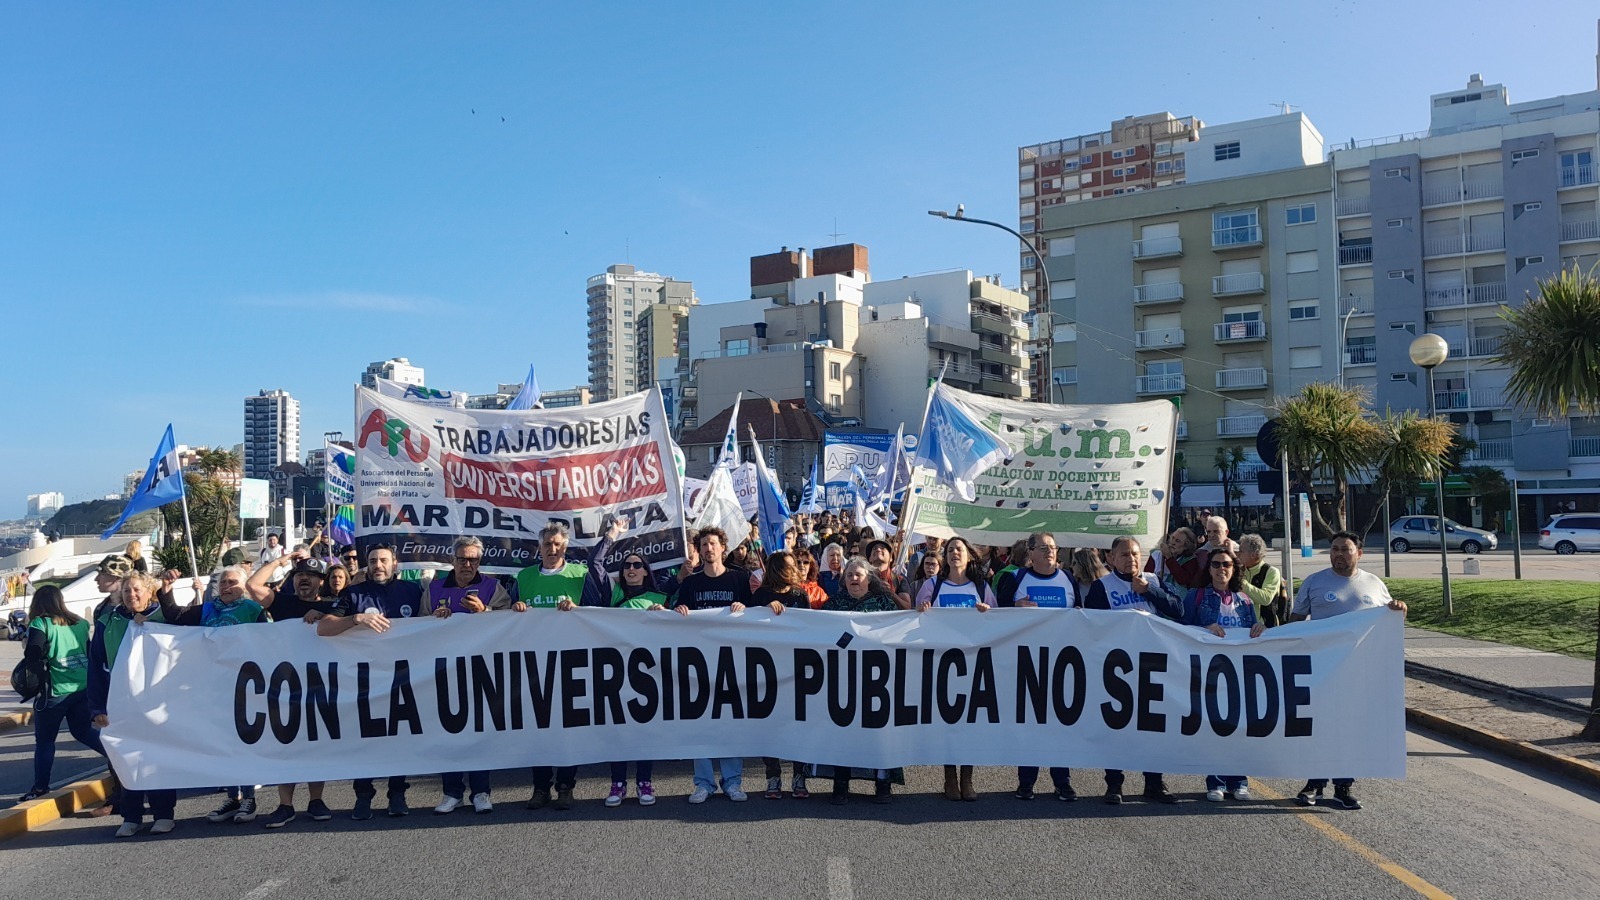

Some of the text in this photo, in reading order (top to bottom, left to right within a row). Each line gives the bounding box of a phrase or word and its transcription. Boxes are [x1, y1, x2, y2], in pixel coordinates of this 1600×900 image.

[358, 408, 431, 463] APU
[433, 411, 651, 454] TRABAJADORES/AS
[395, 469, 406, 477] del
[446, 453, 660, 502] UNIVERSITARIOS/AS
[1047, 470, 1121, 483] DOCENTE
[391, 490, 401, 498] del
[402, 490, 418, 498] Plata
[826, 493, 853, 507] MAR
[1029, 487, 1149, 501] MARPLATENSE
[922, 501, 956, 515] CONADU
[361, 503, 450, 527] MAR
[464, 505, 535, 535] DEL
[1094, 513, 1140, 527] CTA
[511, 548, 529, 559] de
[695, 591, 734, 602] LA UNIVERSIDAD
[233, 631, 1313, 745] CON LA UNIVERSIDAD PÚBLICA NO SE JODE
